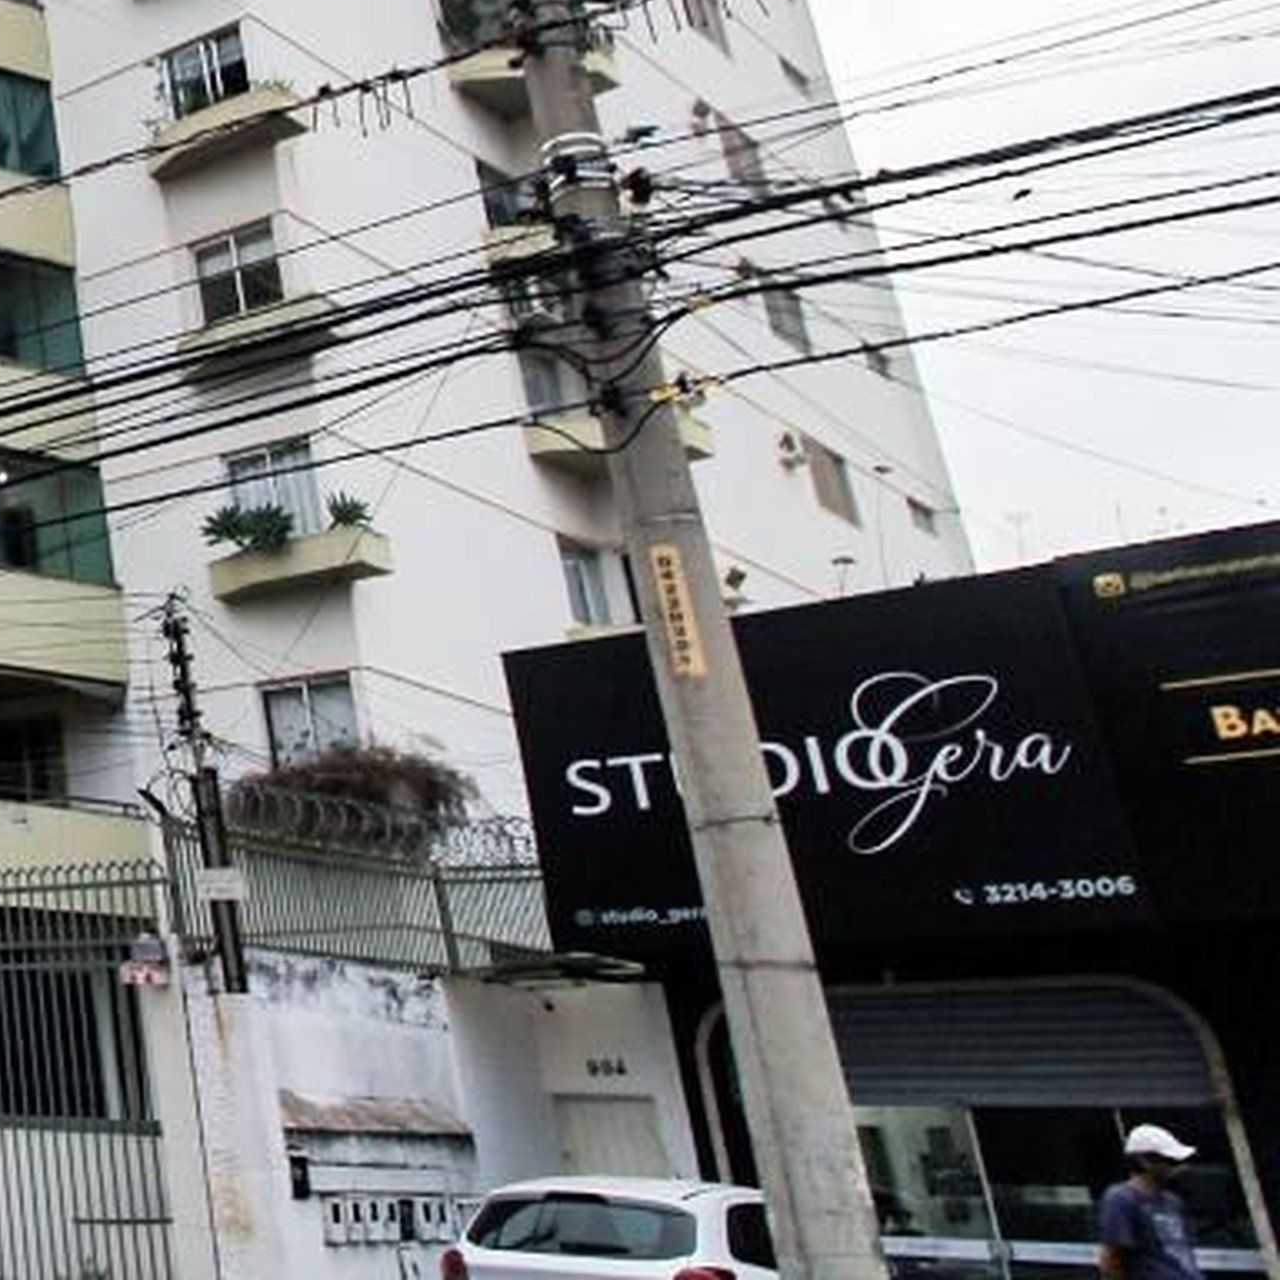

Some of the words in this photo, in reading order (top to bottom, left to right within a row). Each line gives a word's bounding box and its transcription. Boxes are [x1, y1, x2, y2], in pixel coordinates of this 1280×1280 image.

[1209, 704, 1280, 740] BA
[565, 729, 908, 817] STDIO
[847, 671, 1072, 855] Gera
[984, 875, 1136, 904] 3214-3006
[601, 905, 706, 925] studio_ger
